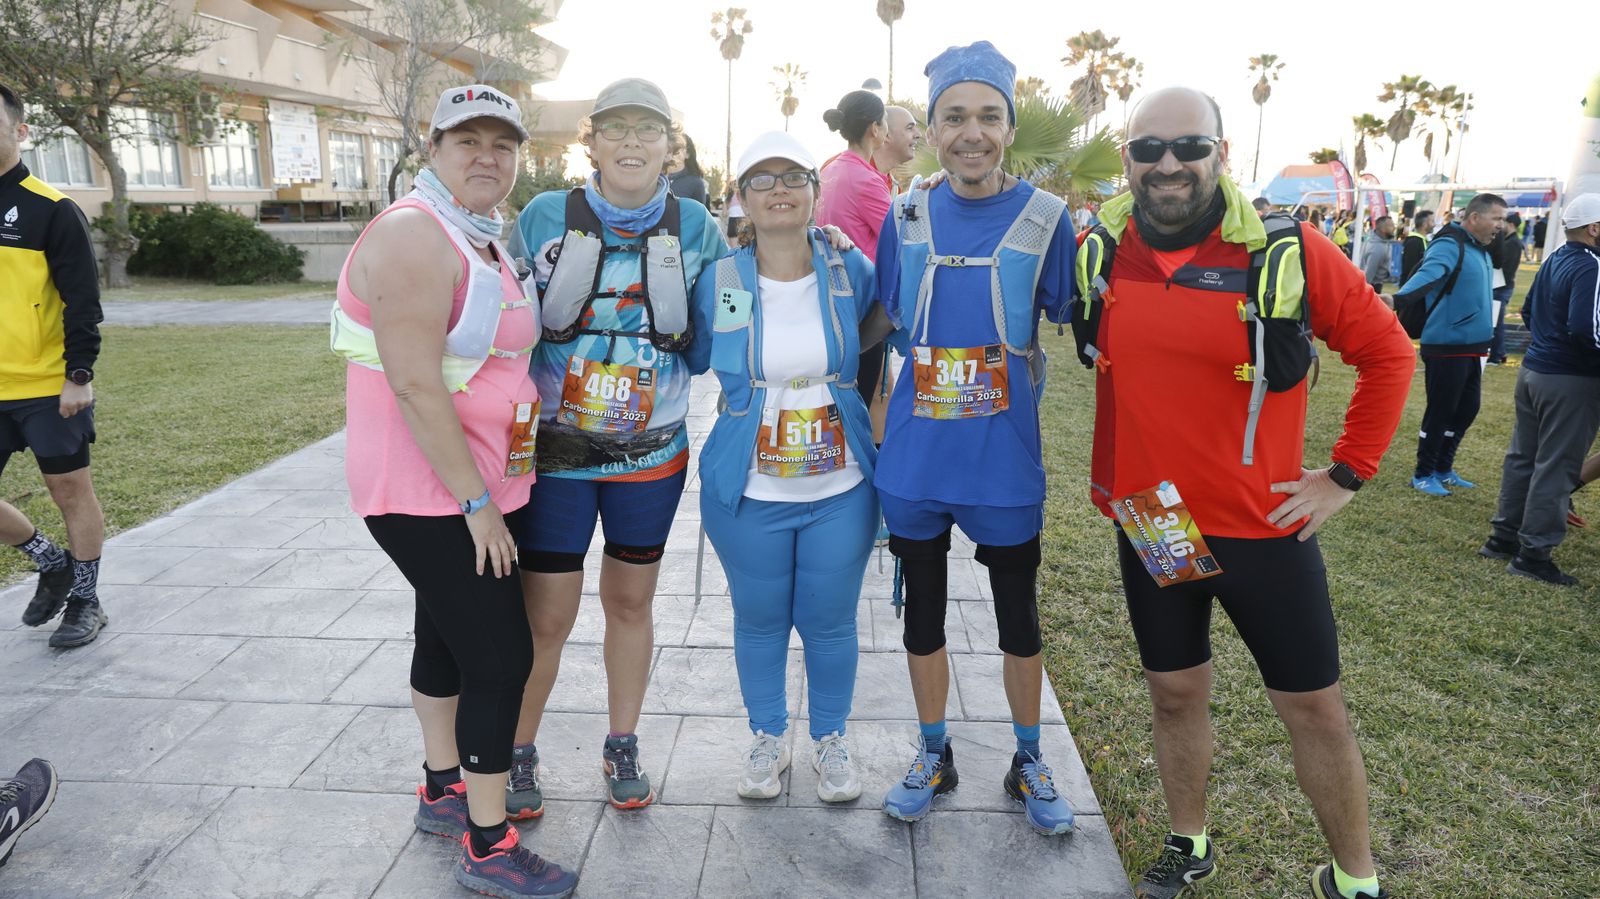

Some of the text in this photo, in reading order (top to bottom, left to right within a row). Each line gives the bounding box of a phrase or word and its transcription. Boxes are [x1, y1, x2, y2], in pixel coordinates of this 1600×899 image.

[451, 89, 513, 110] GIANT
[936, 359, 978, 385] 347
[584, 372, 632, 402] 468
[916, 391, 974, 404] Carbonerilla
[977, 390, 1003, 402] 2023
[563, 399, 620, 419] Carbonerilla
[622, 411, 647, 422] 2023
[786, 418, 822, 446] 511
[759, 451, 820, 463] Carbonerilla
[822, 447, 842, 460] 2023
[1124, 499, 1160, 557] Carbonerilla
[1158, 558, 1177, 580] 2023
[1153, 512, 1195, 558] 346
